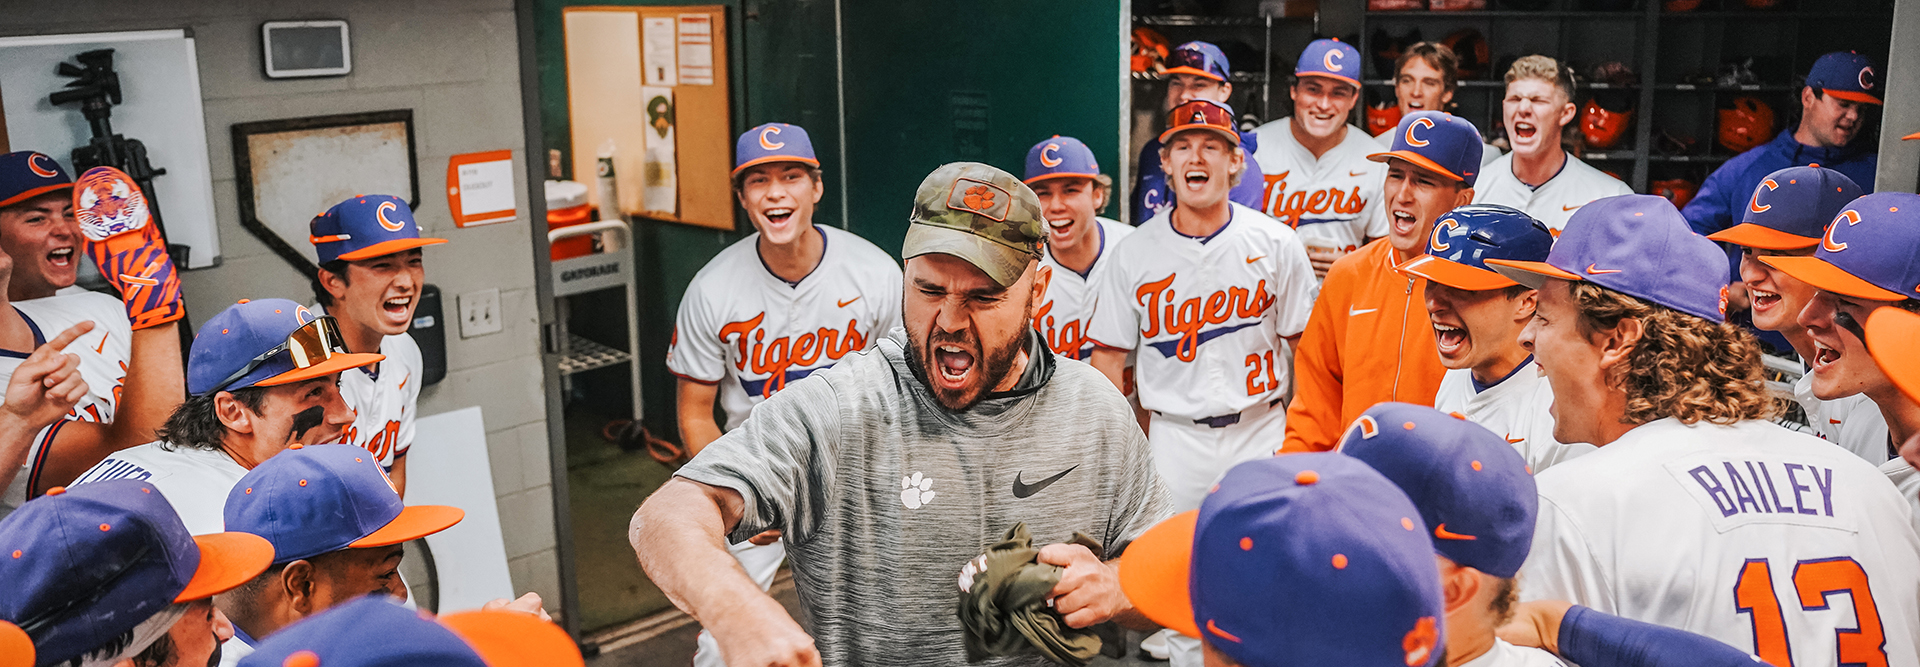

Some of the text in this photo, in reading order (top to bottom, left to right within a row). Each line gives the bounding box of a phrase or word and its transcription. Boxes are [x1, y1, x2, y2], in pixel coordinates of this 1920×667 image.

[1324, 48, 1344, 72] C
[1858, 66, 1874, 90] C
[759, 126, 785, 151] C
[1405, 117, 1435, 148] C
[28, 153, 58, 178] C
[1040, 143, 1063, 168] C
[1144, 189, 1158, 209] C
[1262, 169, 1368, 232] Tigers
[1751, 178, 1779, 214] C
[376, 201, 405, 232] C
[1823, 209, 1862, 252] C
[1431, 218, 1460, 252] C
[1136, 272, 1276, 362] Tigers
[719, 311, 869, 399] Tigers
[1245, 350, 1278, 396] 21
[1688, 460, 1834, 518] BAILEY
[1733, 556, 1889, 667] 13
